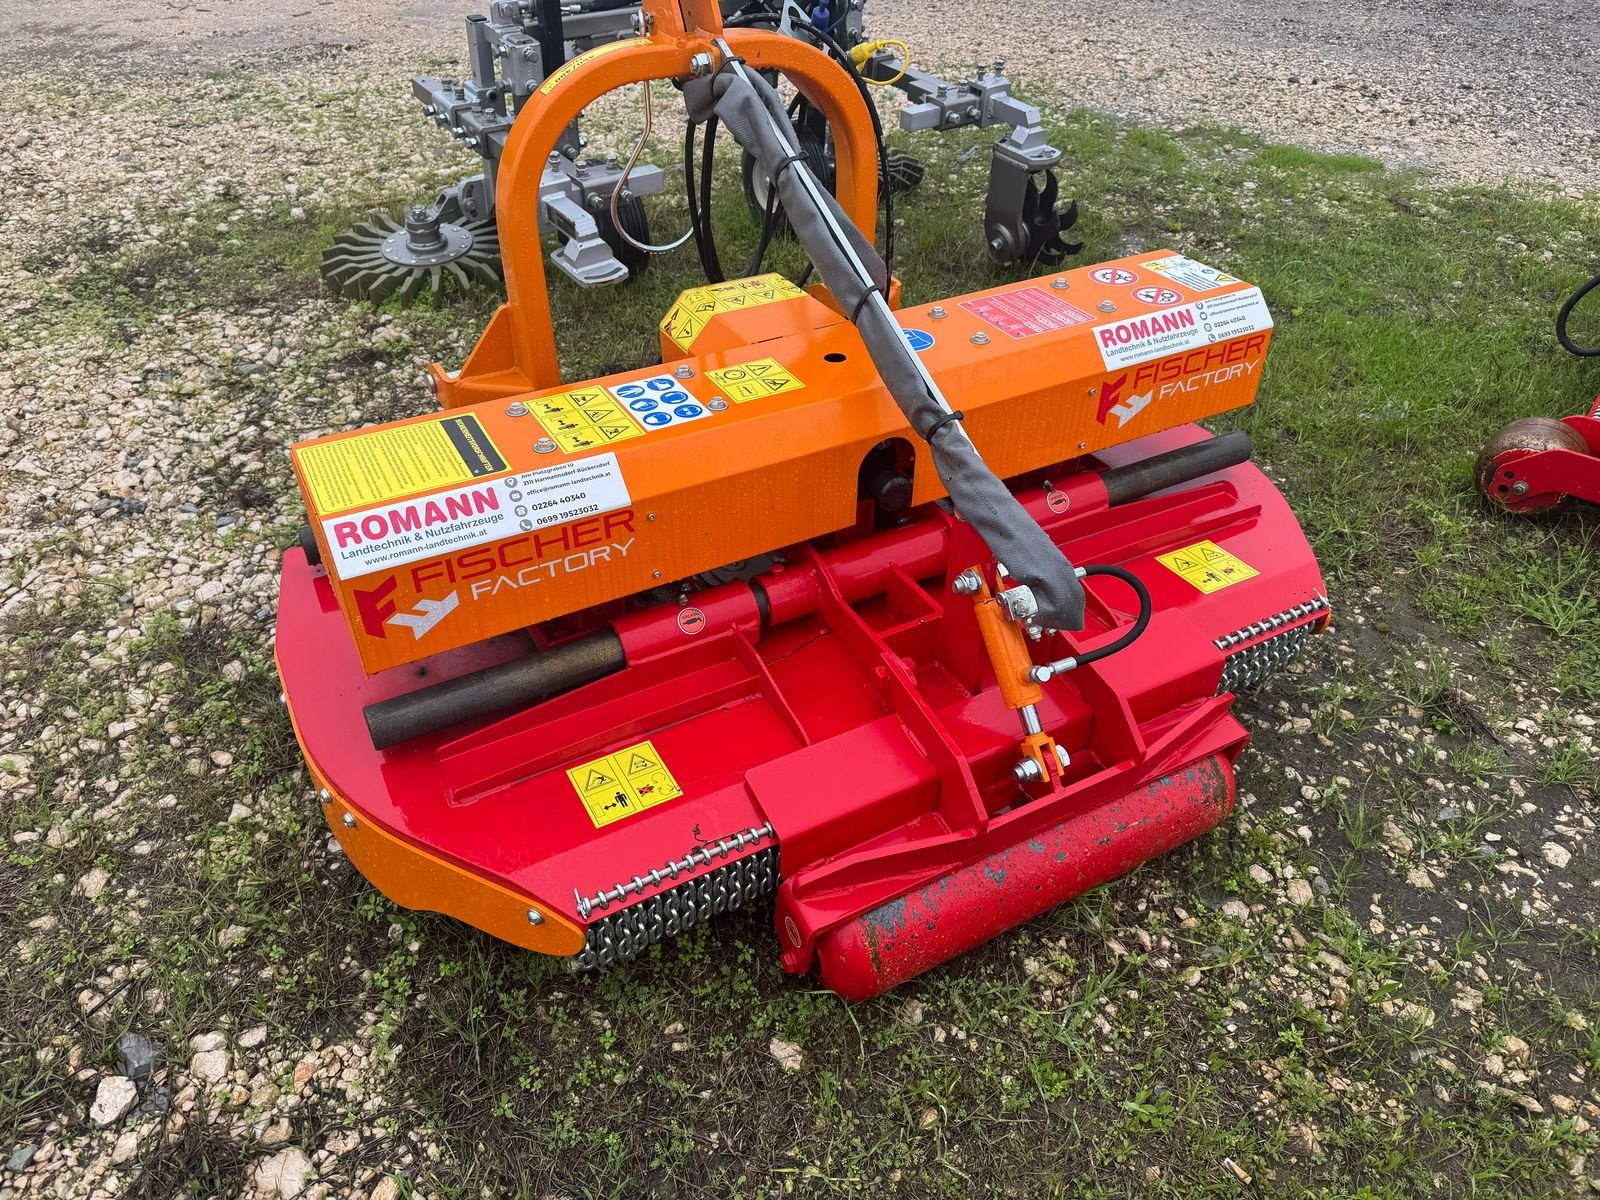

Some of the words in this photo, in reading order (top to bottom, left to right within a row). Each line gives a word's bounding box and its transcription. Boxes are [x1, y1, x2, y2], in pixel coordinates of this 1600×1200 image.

[1099, 308, 1195, 349] ROMANN
[1105, 341, 1147, 357] Landtechnik
[1153, 328, 1199, 346] Nutzfahrzeuge
[1120, 339, 1190, 363] www.romann-landtechnik.at
[1132, 333, 1266, 390] FISCHER
[1158, 358, 1260, 401] FACTORY
[333, 487, 500, 549] ROMANN
[531, 499, 559, 511] 02264
[559, 491, 587, 504] 40340
[536, 514, 559, 525] 0699
[559, 504, 600, 520] 19523032
[341, 535, 412, 561] Landtechnik
[414, 532, 423, 541] &
[424, 512, 505, 539] Nutzfahrzeuge
[364, 528, 488, 566] www.romann-landtechnik.at
[410, 508, 636, 594] FISCHER
[470, 537, 636, 601] FACTORY
